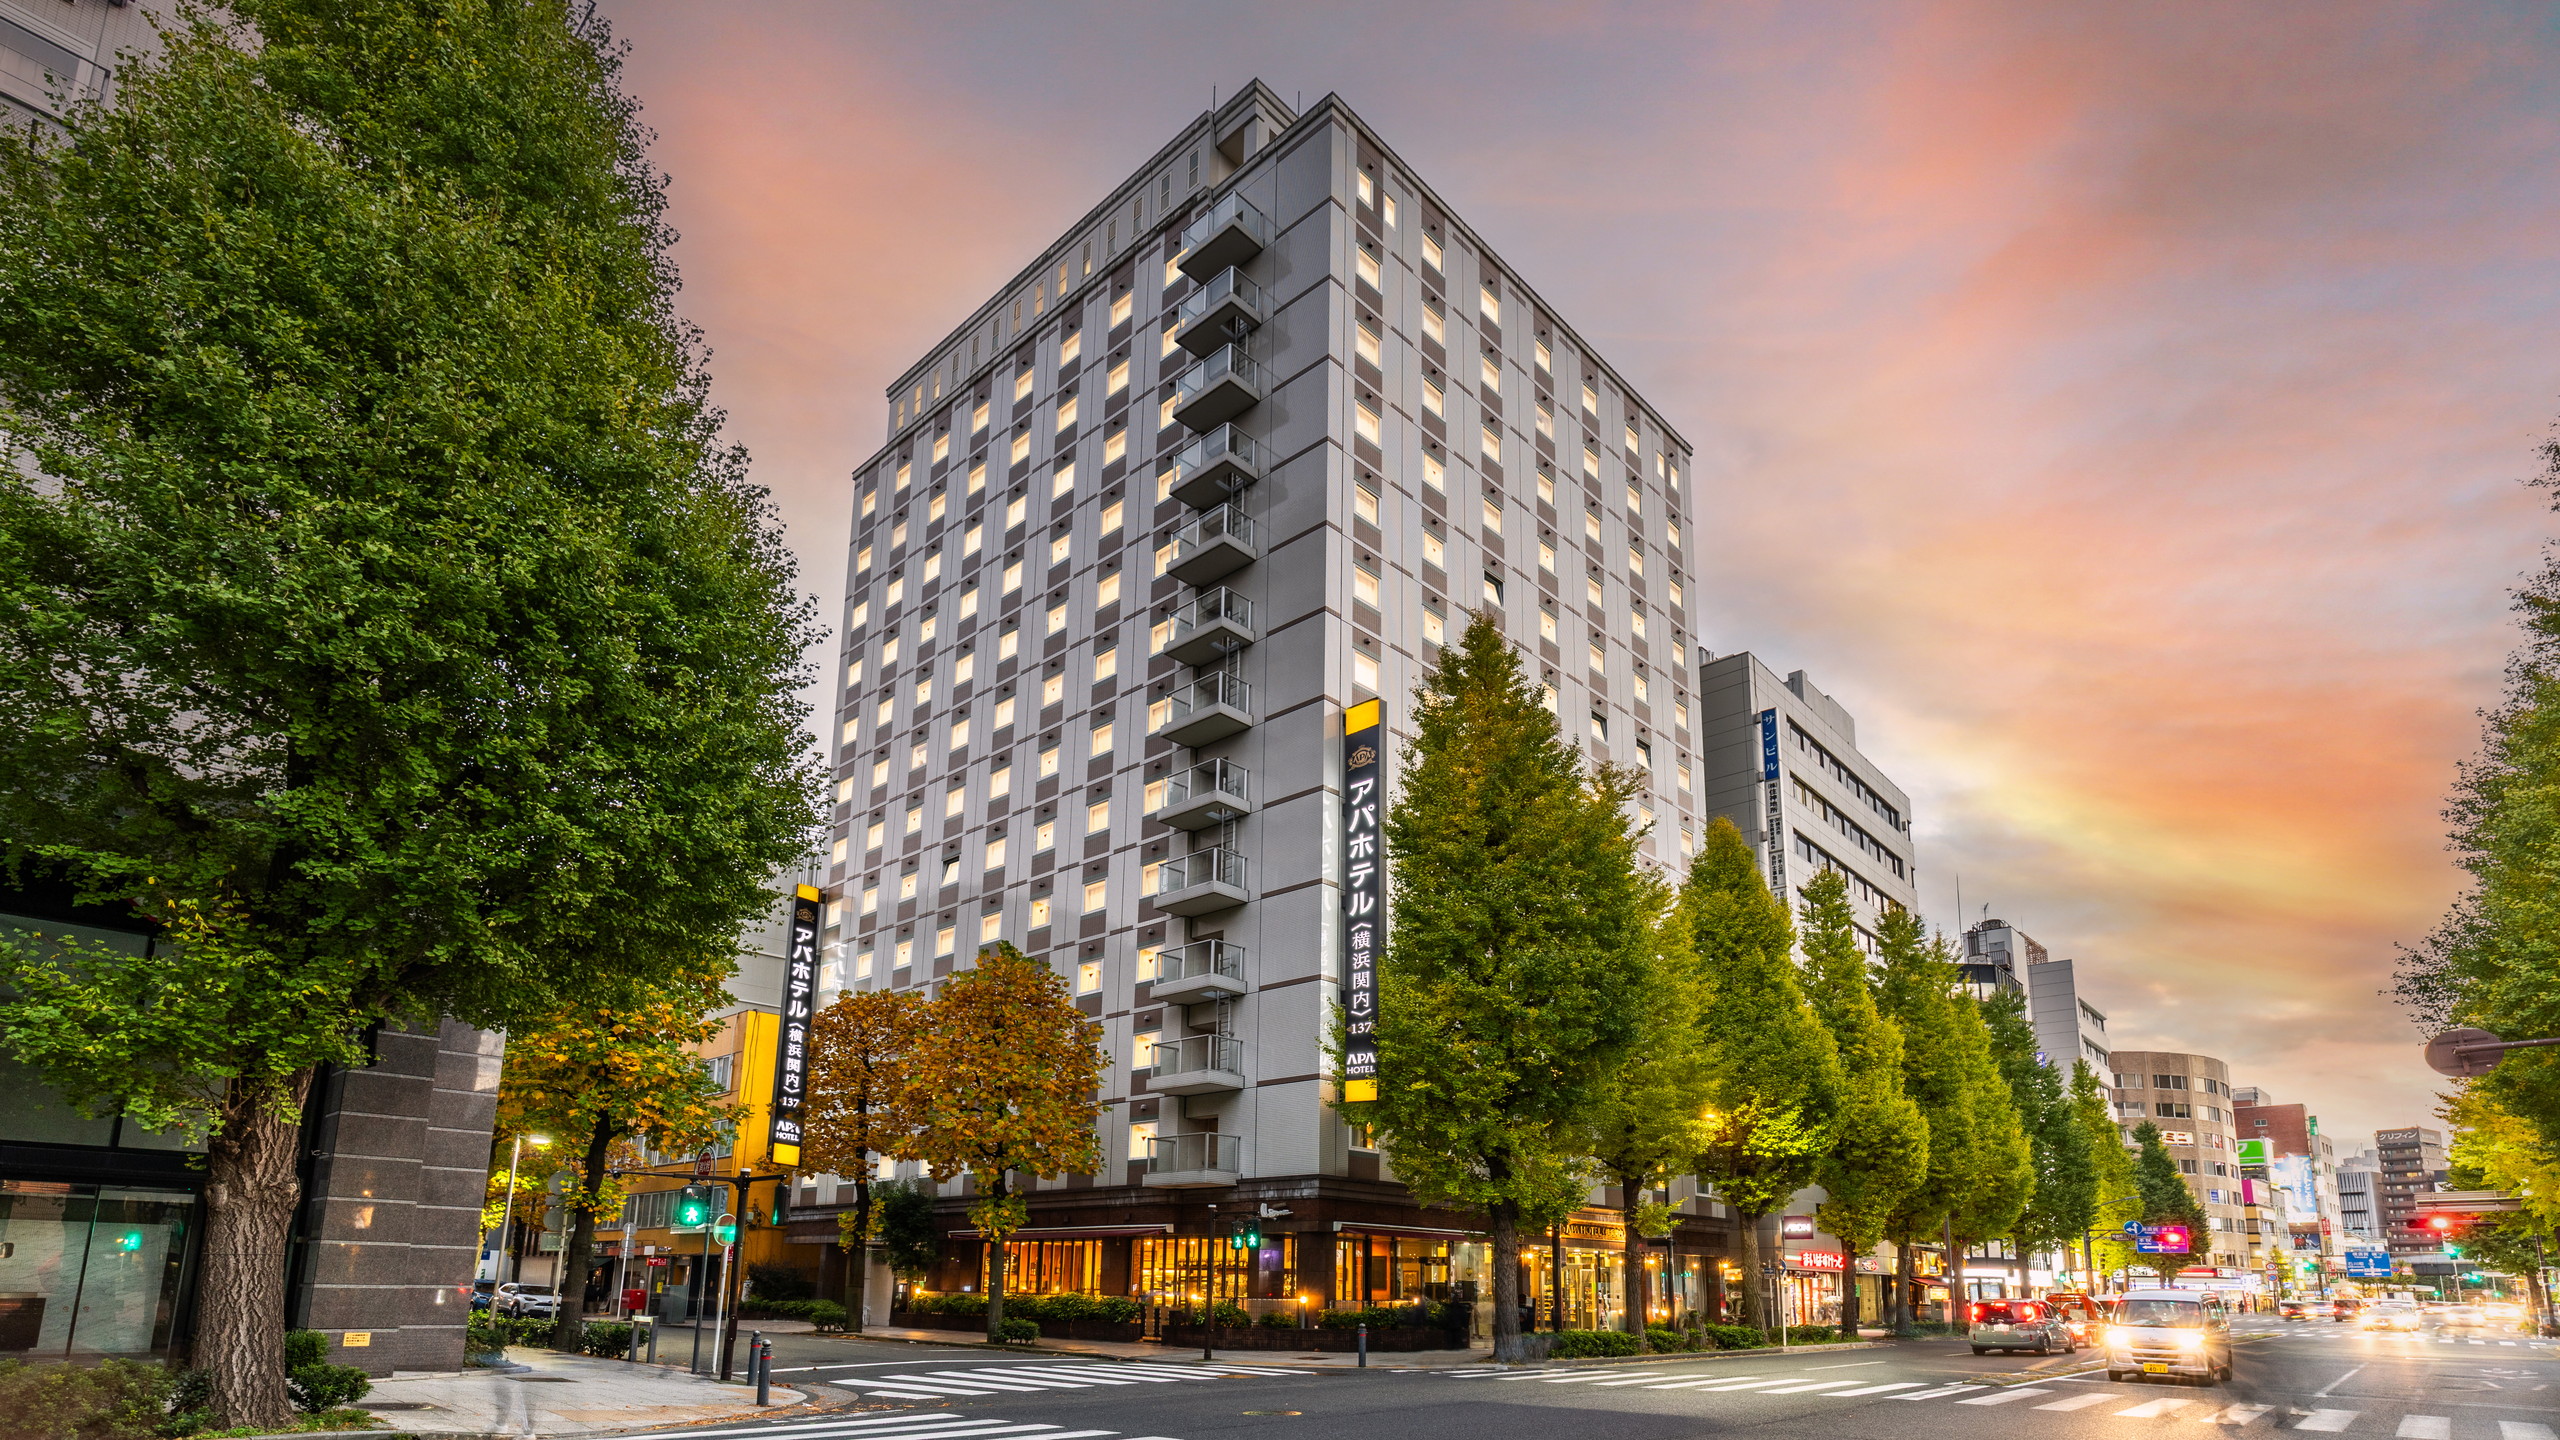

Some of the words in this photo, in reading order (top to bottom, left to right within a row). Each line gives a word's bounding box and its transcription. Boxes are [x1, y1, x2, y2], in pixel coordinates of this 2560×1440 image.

[1763, 714, 1778, 773] サンビル
[1351, 1022, 1373, 1035] 137
[1346, 1053, 1376, 1065] APA
[1346, 1065, 1376, 1075] HOTEL
[782, 1097, 800, 1108] 137
[775, 1131, 800, 1142] HOTEL
[2379, 1131, 2418, 1141] グリフィン
[1580, 1225, 1603, 1236] HOTEL
[1802, 1252, 1844, 1269] まいばすけっと
